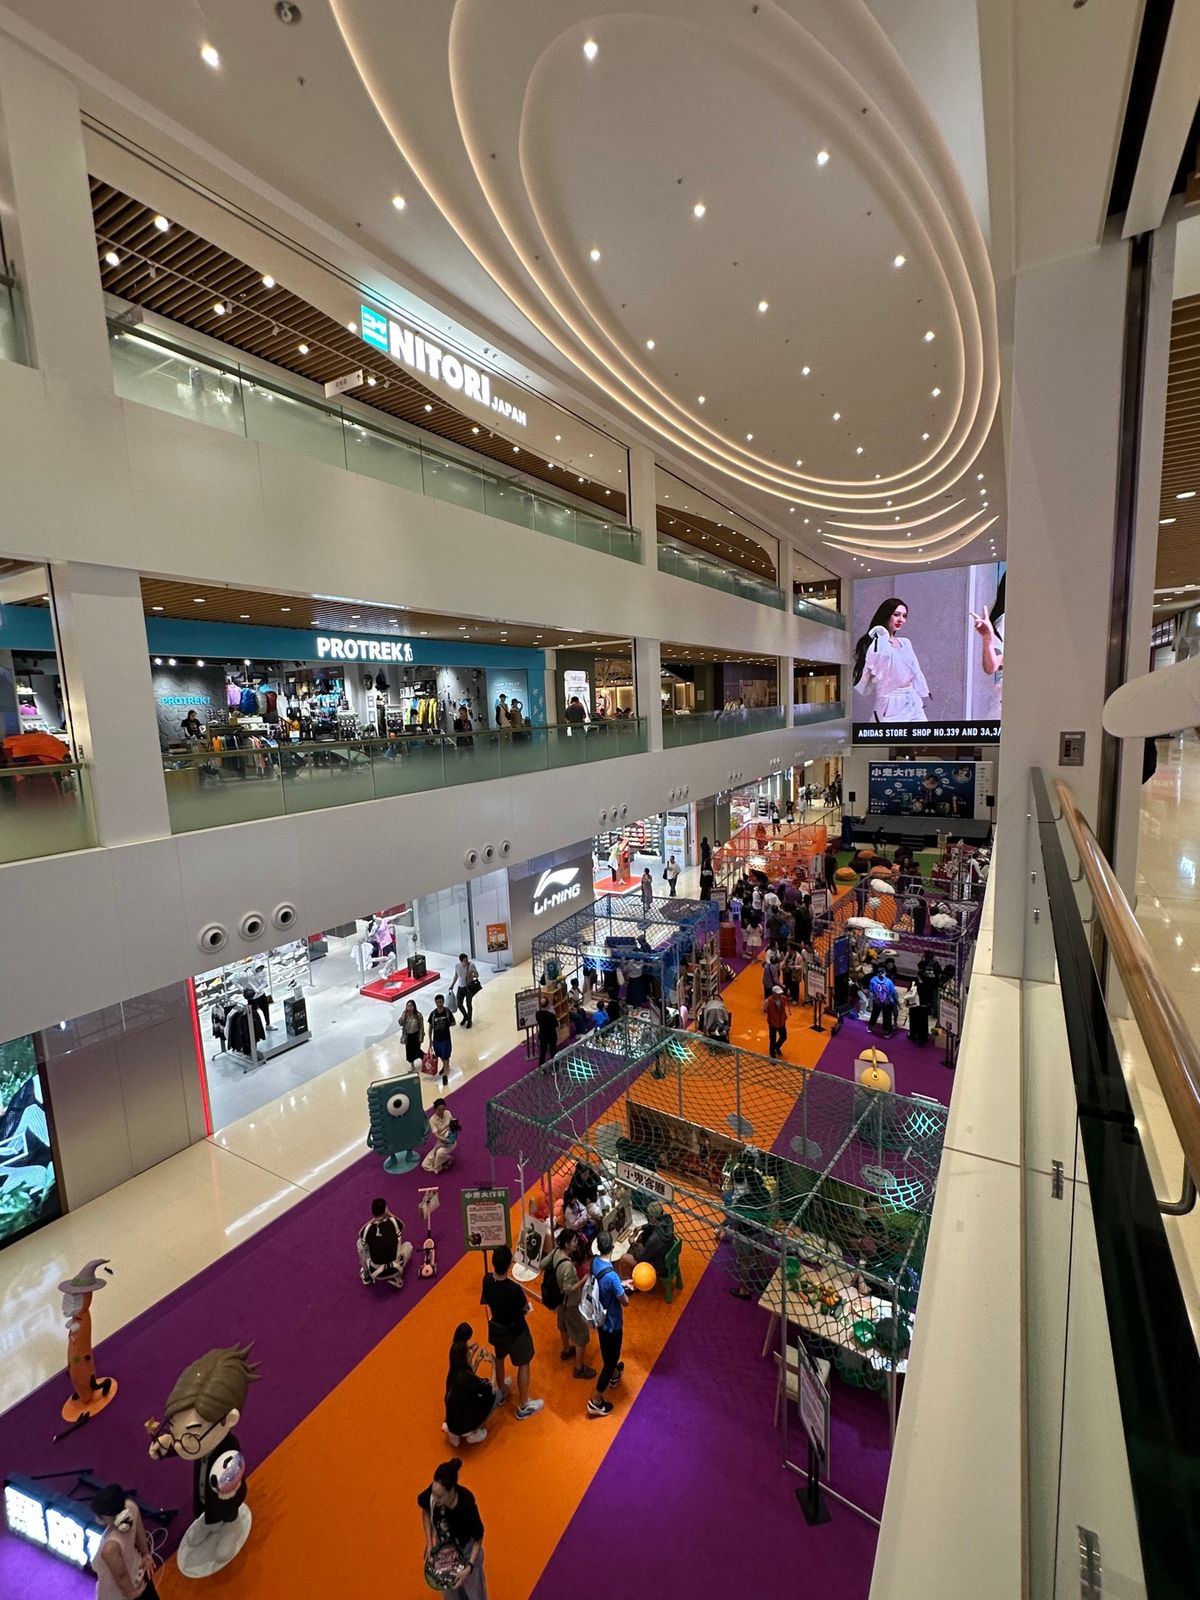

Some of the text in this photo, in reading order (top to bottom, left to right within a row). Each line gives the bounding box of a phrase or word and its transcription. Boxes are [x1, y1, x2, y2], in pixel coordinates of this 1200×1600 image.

[389, 320, 527, 426] NITORI JAPAN
[316, 637, 403, 661] PROTREK
[161, 696, 207, 705] PROTREK
[858, 729, 883, 738] ADIDAS
[885, 729, 907, 737] STORE
[912, 728, 931, 737] SHOP
[933, 728, 959, 737] NO.339
[961, 727, 977, 736] AND
[533, 883, 581, 916] LI-NING
